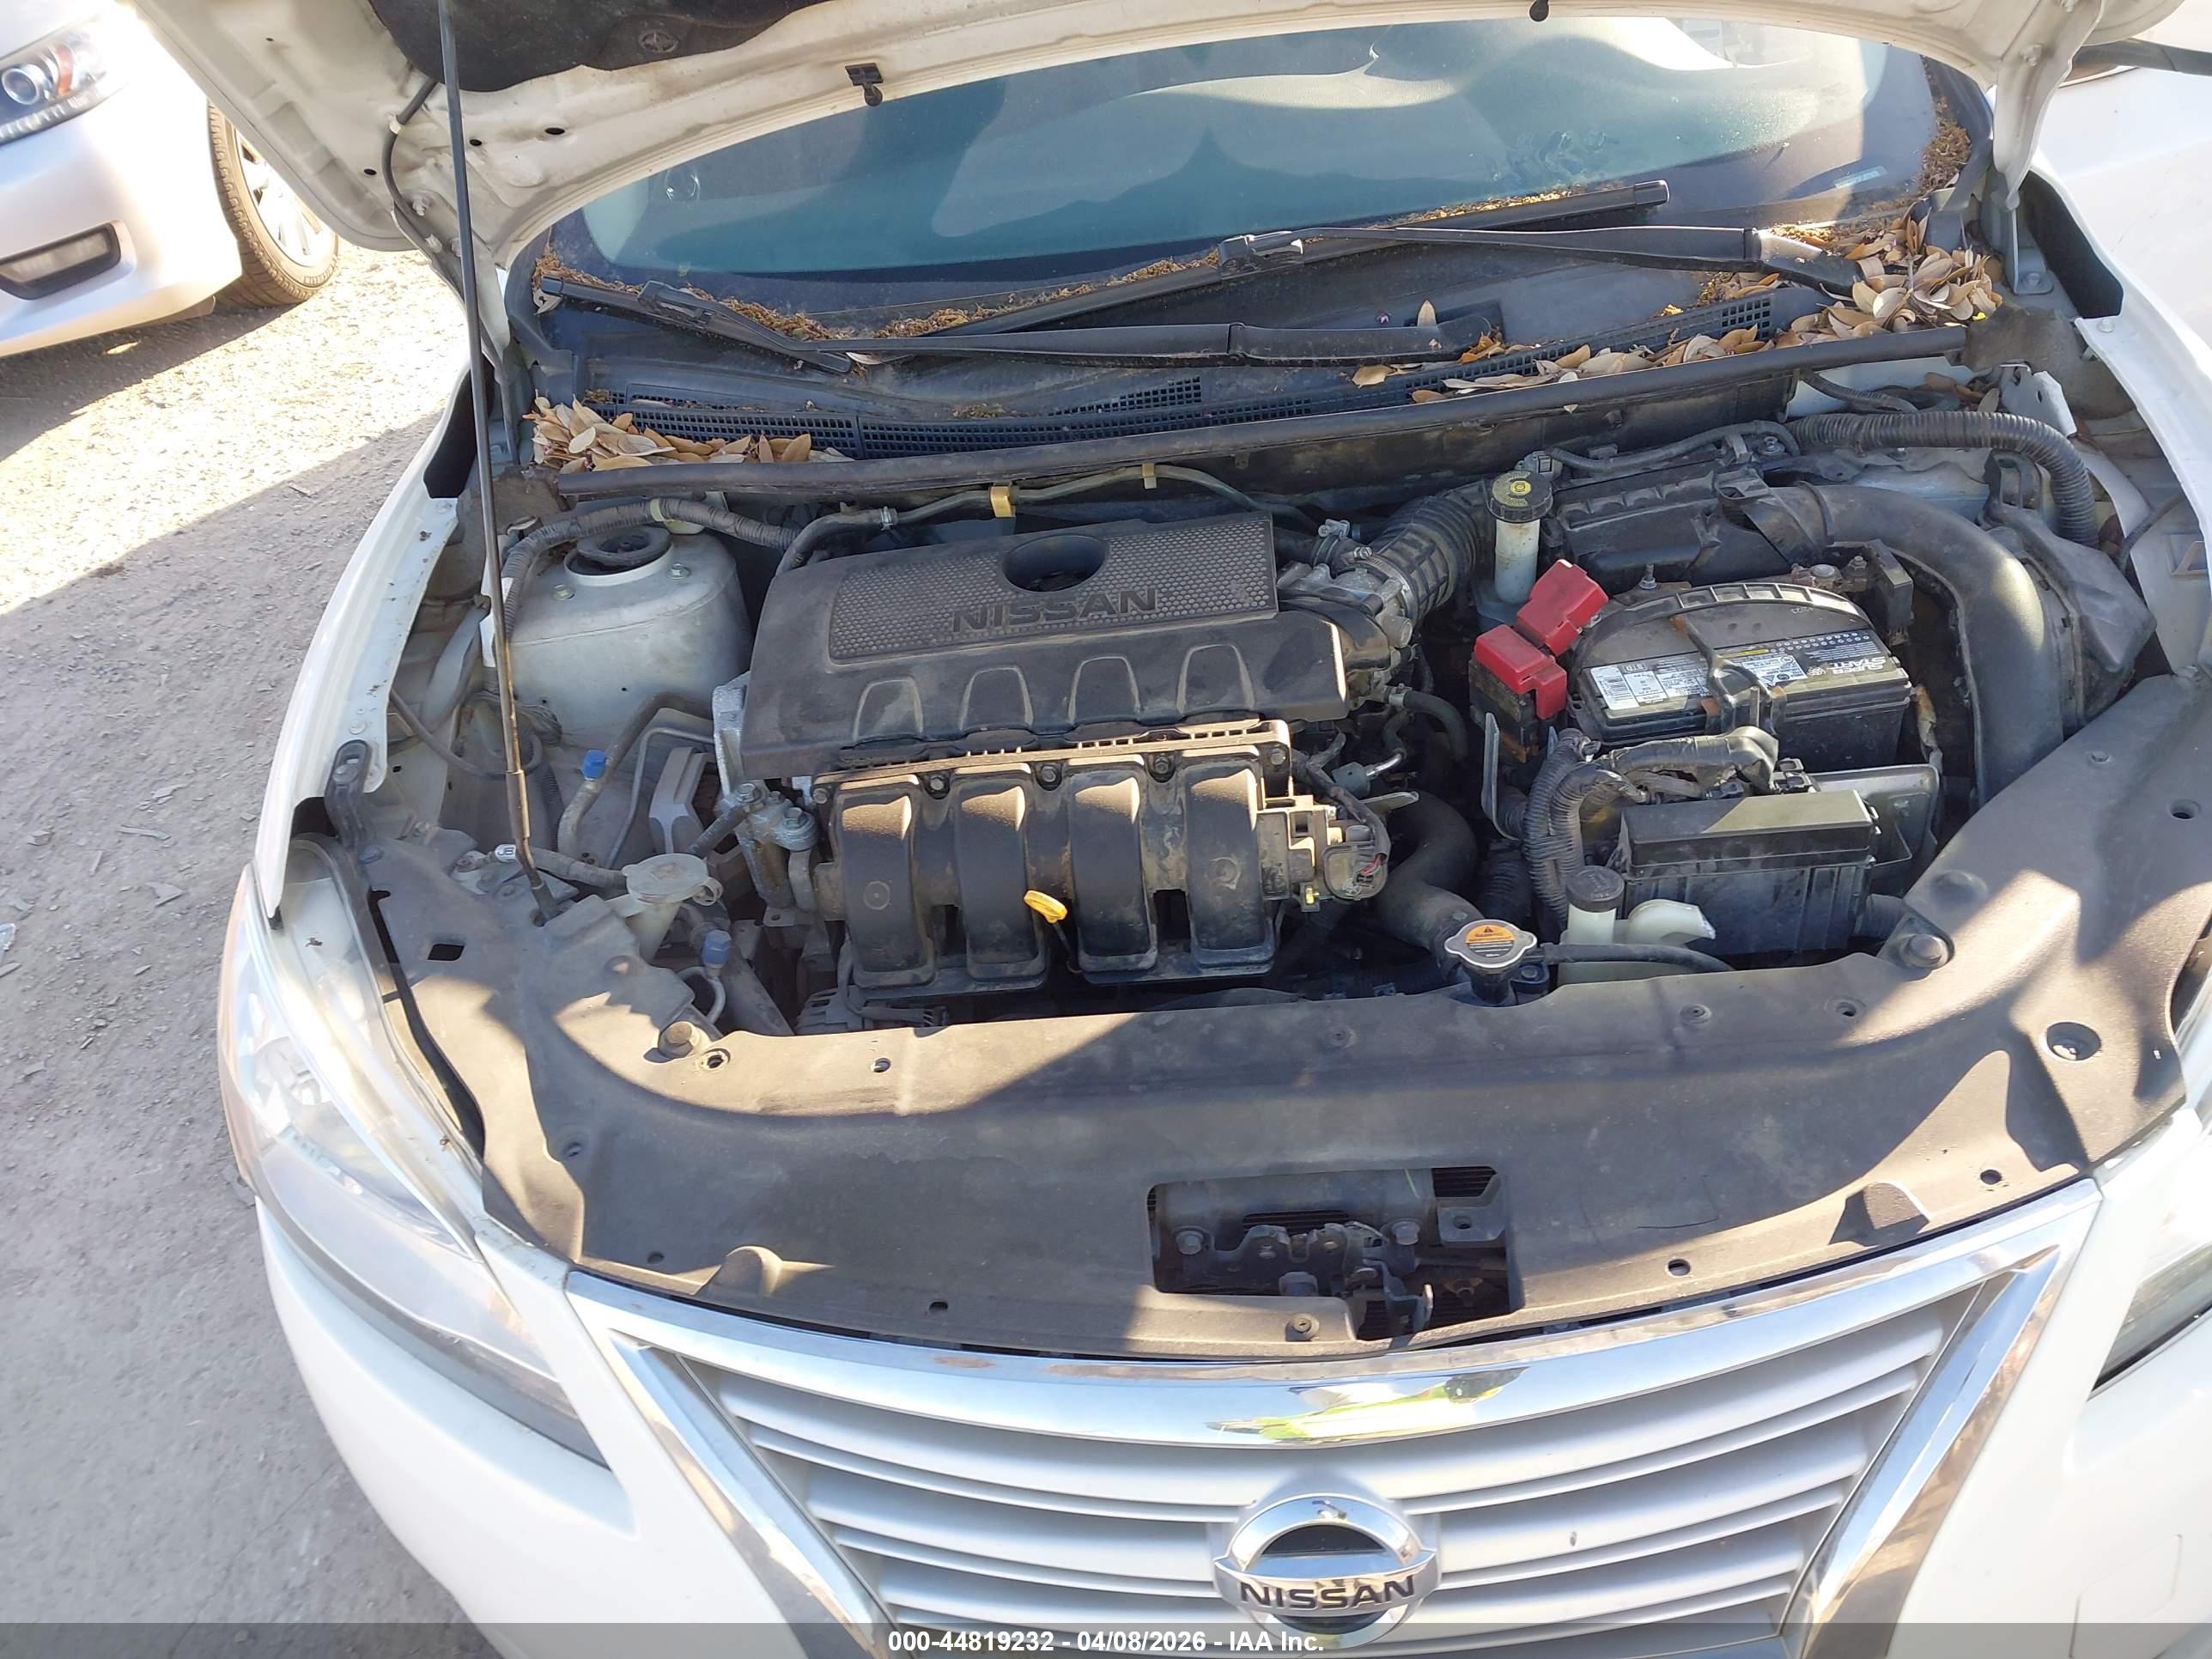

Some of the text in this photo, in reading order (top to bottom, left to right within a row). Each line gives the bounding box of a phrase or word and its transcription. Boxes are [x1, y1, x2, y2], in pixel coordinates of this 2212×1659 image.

[951, 589, 1158, 633] NISSAN
[1830, 656, 1887, 668] START
[1832, 663, 1884, 675] SUPER
[1239, 1575, 1415, 1609] NISSAN
